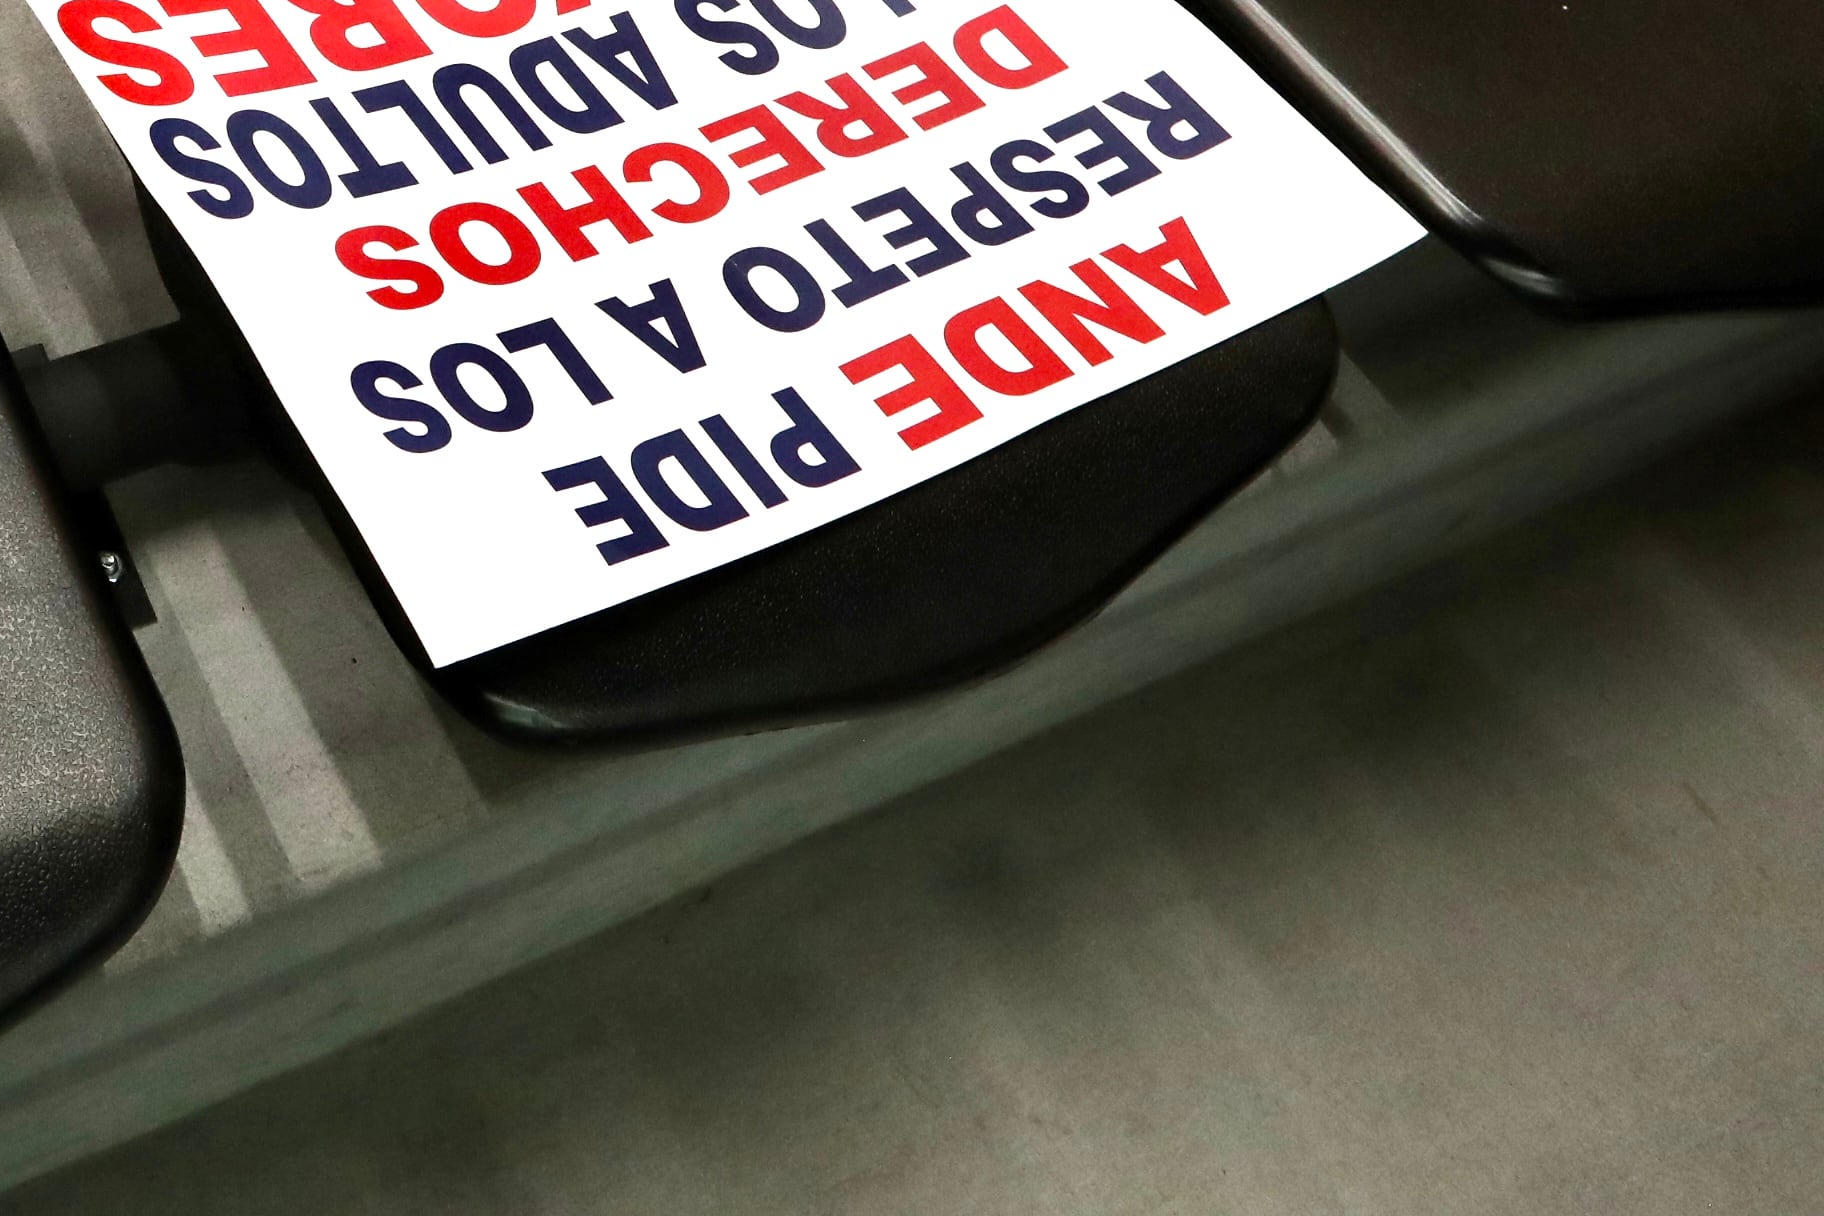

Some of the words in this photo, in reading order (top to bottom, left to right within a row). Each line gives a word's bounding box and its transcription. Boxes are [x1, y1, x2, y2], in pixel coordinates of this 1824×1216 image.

[150, 11, 678, 219] ADULTOS
[335, 4, 1068, 310] DERECHOS
[723, 71, 1232, 332] RESPETO
[351, 318, 614, 453] LOS
[595, 278, 706, 373] A
[839, 216, 1230, 451] ANDE
[541, 387, 862, 566] PIDE
